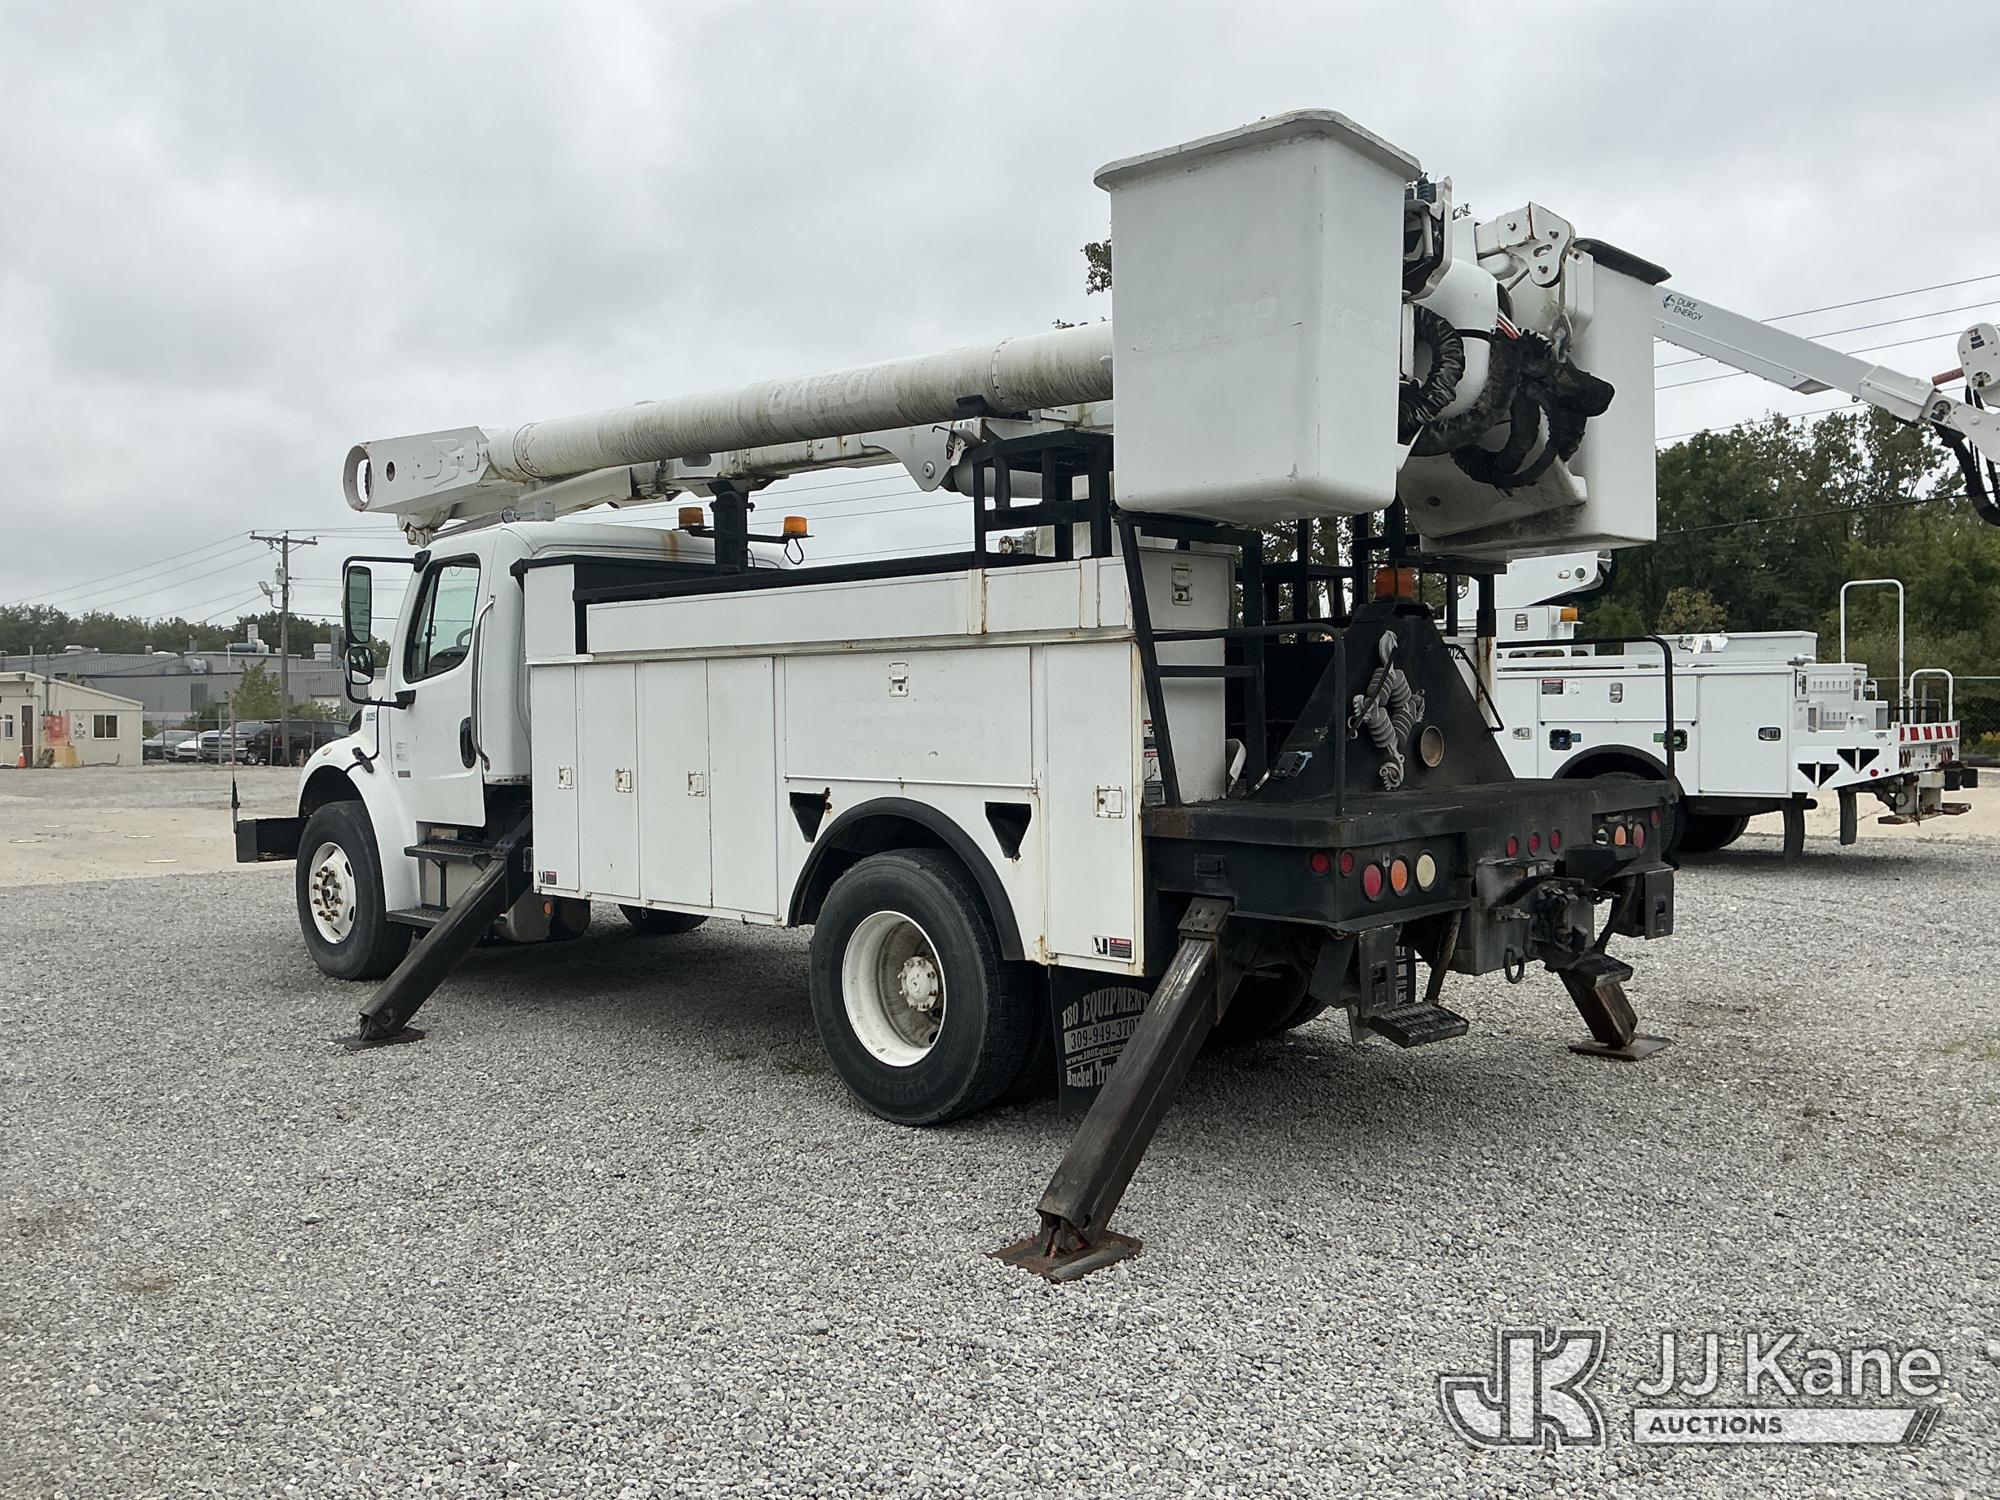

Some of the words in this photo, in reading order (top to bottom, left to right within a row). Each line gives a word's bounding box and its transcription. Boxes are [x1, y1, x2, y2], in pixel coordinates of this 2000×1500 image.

[1673, 305, 1703, 321] ENERGY
[1677, 297, 1698, 310] DUKE
[1083, 987, 1150, 1024] EQUIPMENT
[1071, 1017, 1140, 1050] 309-949-370
[1066, 1063, 1094, 1088] Bucket
